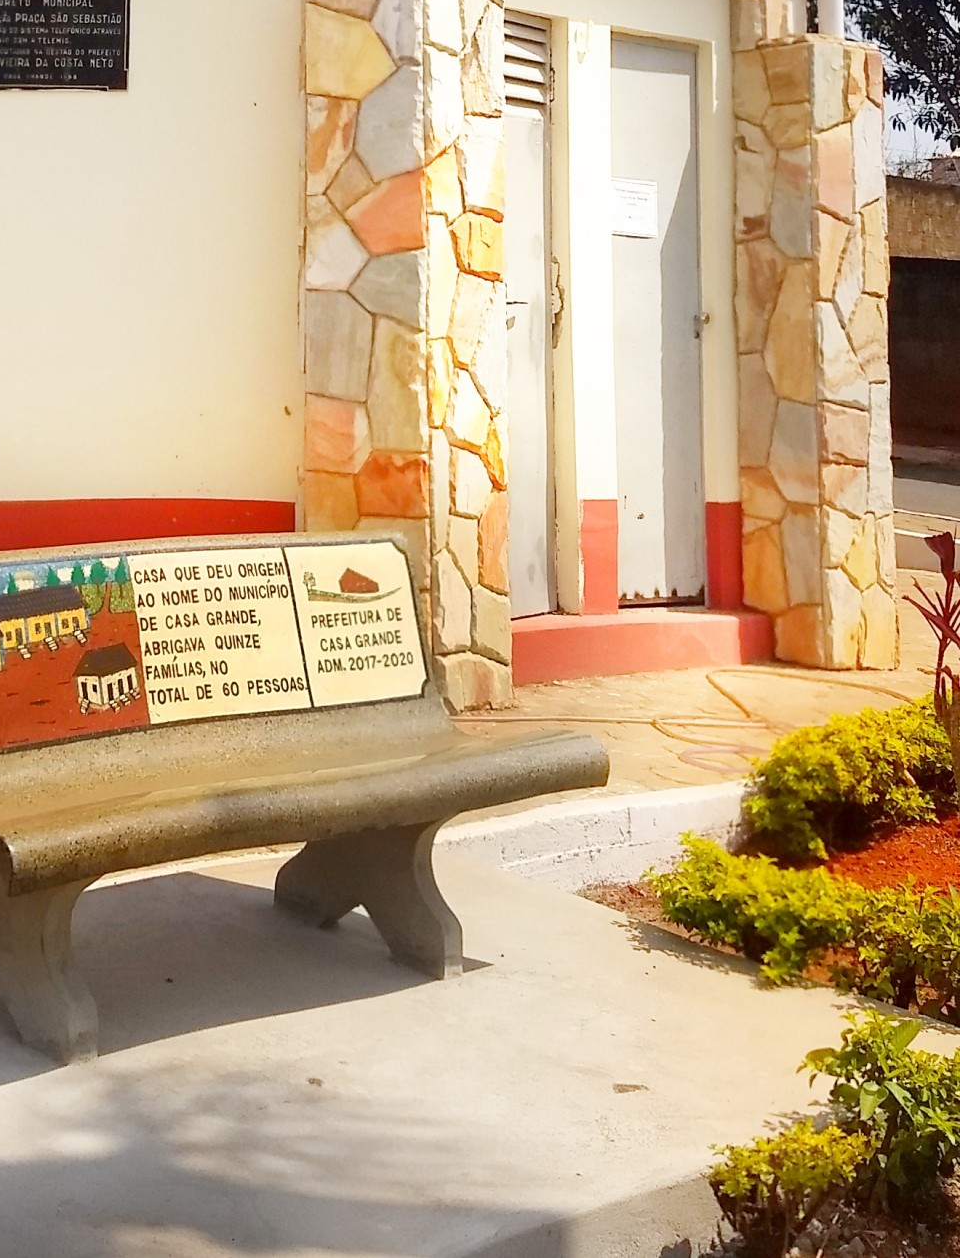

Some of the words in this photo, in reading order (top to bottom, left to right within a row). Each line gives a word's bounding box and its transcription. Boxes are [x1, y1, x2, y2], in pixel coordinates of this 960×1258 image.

[15, 13, 46, 24] PRAÇA
[50, 12, 68, 23] SÃO
[72, 12, 122, 24] SEBASTIÃO
[0, 56, 30, 68] VIEIRA
[35, 57, 49, 68] DA
[54, 57, 84, 68] COSTA
[89, 57, 114, 68] NETO
[75, 48, 85, 56] DO
[87, 48, 121, 57] PREFEITO
[134, 568, 167, 585] CASA
[174, 566, 201, 581] QUE
[207, 564, 233, 580] DEU
[238, 562, 285, 578] ORIGEM
[137, 593, 155, 608] AO
[162, 591, 199, 606] NOME
[205, 587, 223, 603] DO
[229, 580, 289, 601] MUNICÍPIO
[139, 615, 158, 632] DE
[165, 613, 199, 630] CASA
[206, 609, 262, 627] GRANDE,
[311, 610, 382, 629] PREFEITURA
[387, 608, 403, 622] DE
[144, 638, 206, 657] ABRIGAVA
[214, 634, 261, 651] QUINZE
[320, 637, 352, 652] CASA
[355, 630, 403, 647] GRANDE
[146, 655, 206, 680] FAMÍLIAS,
[210, 660, 229, 676] NO
[317, 658, 347, 674] ADM.
[349, 651, 414, 671] 2017-2020
[149, 688, 190, 705] TOTAL
[196, 685, 213, 700] DE
[223, 681, 240, 697] 60
[247, 677, 309, 696] PESSOAS.
